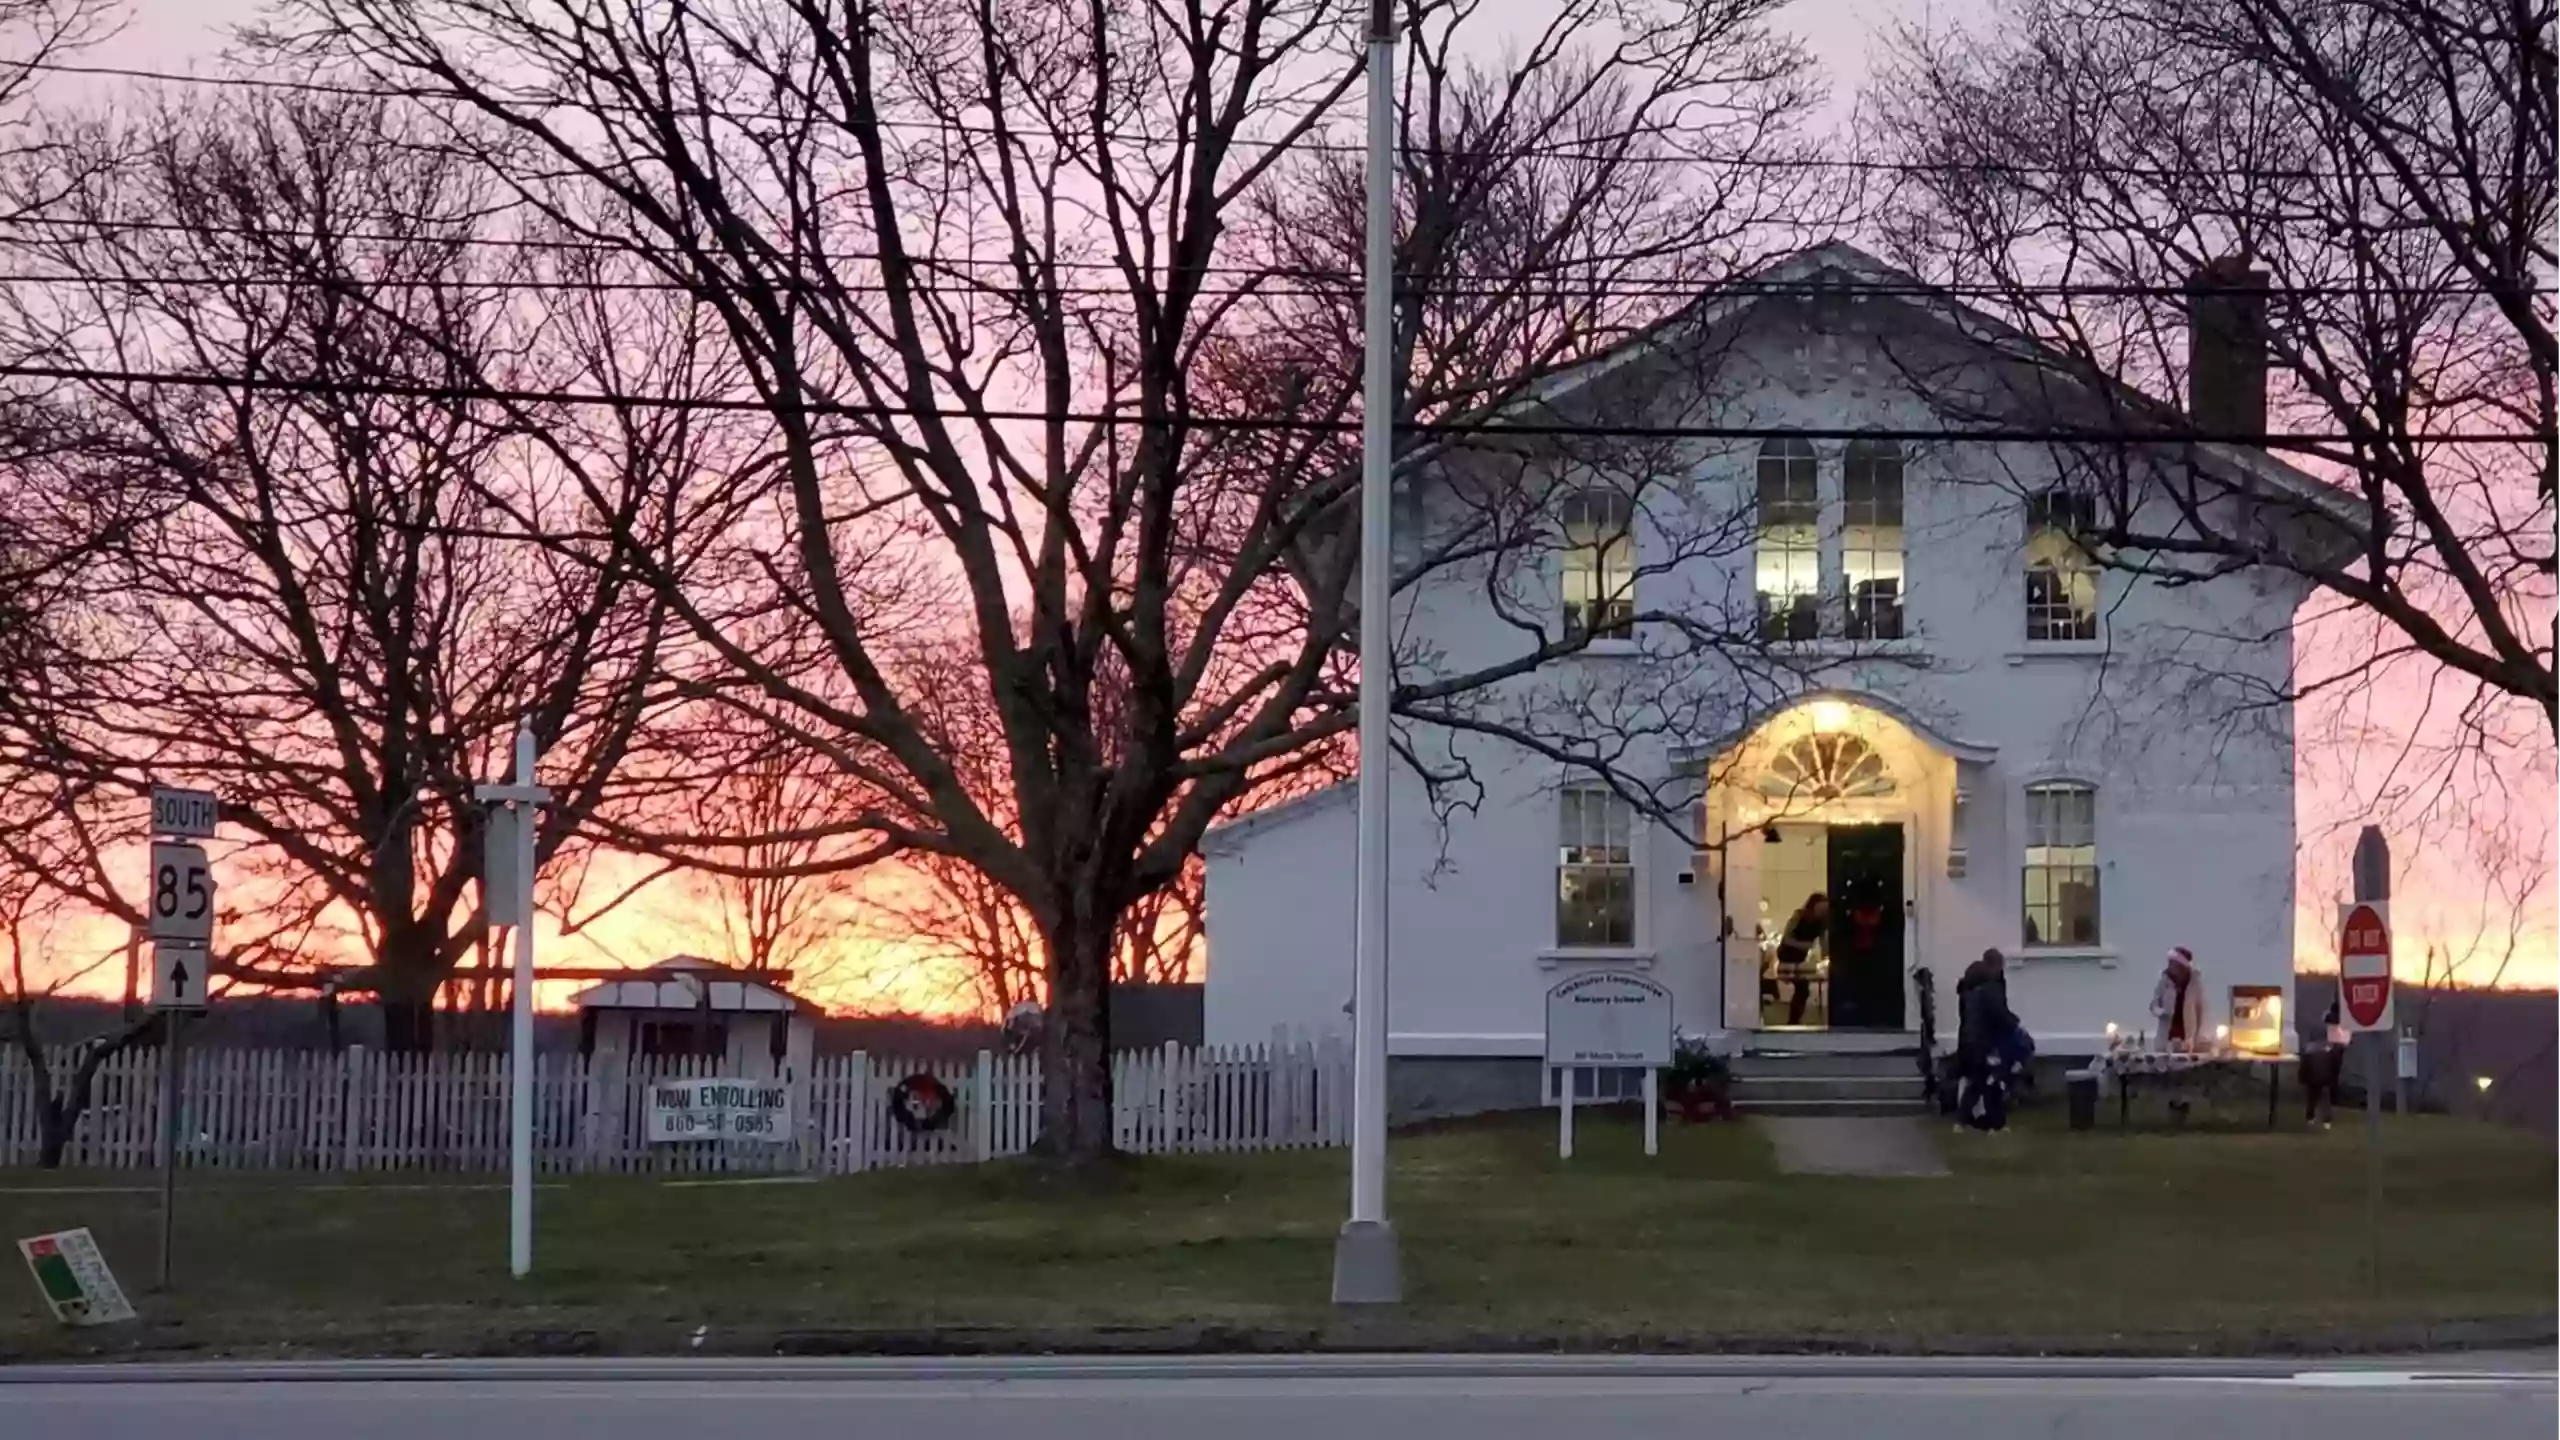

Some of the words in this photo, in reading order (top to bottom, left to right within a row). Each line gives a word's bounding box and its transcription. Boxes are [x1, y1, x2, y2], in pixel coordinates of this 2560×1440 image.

[155, 797, 213, 828] SOUTH
[156, 864, 208, 920] 85
[656, 1088, 692, 1109] NOW
[699, 1086, 785, 1108] ENROLLING
